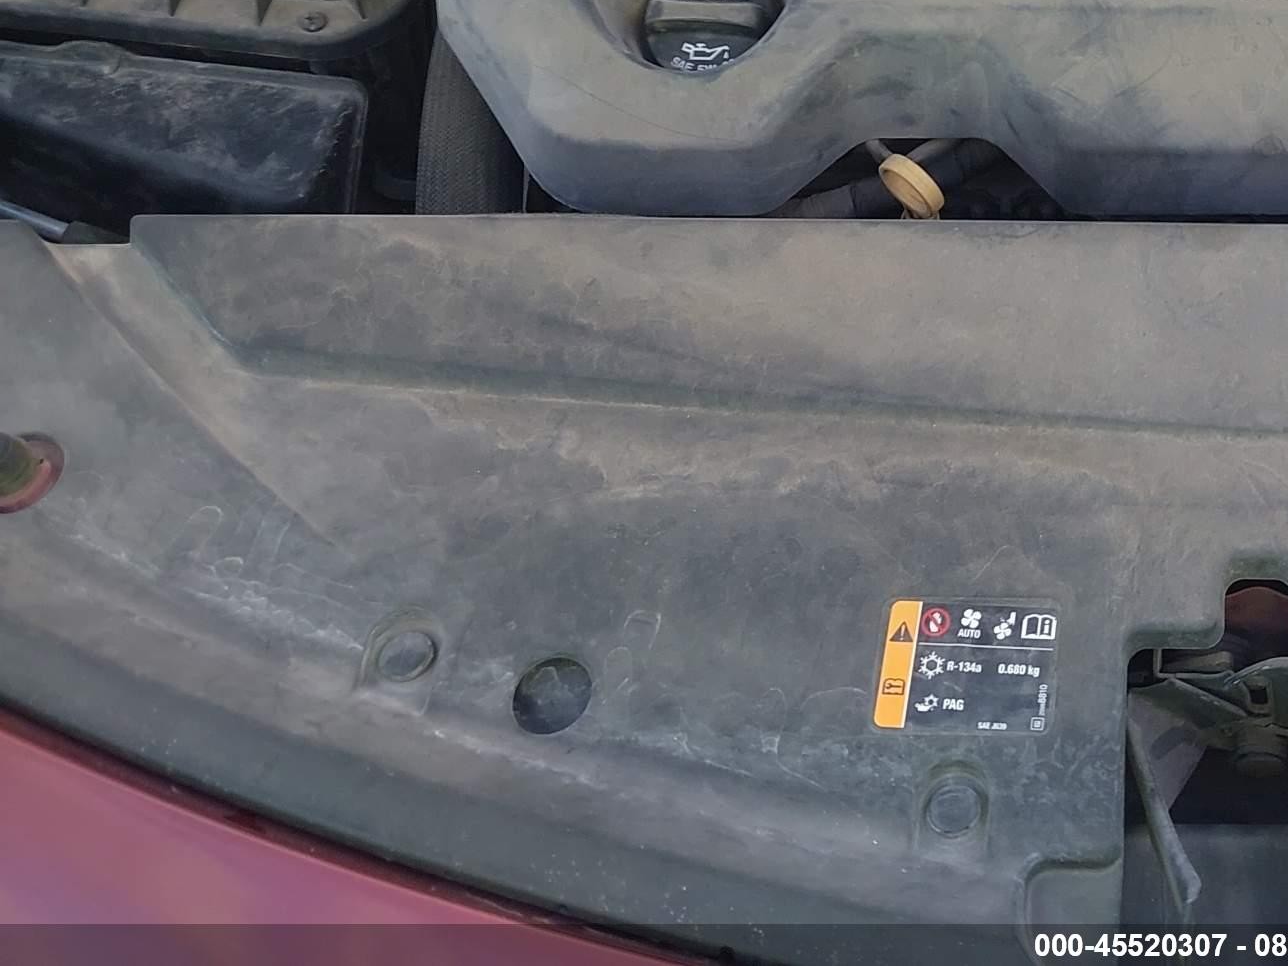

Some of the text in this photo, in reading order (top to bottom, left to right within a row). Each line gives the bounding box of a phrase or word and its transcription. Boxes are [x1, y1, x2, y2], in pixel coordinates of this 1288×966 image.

[957, 628, 981, 639] AUTO
[946, 660, 1041, 677] R-134a 0.680 kg
[942, 698, 965, 711] PAG
